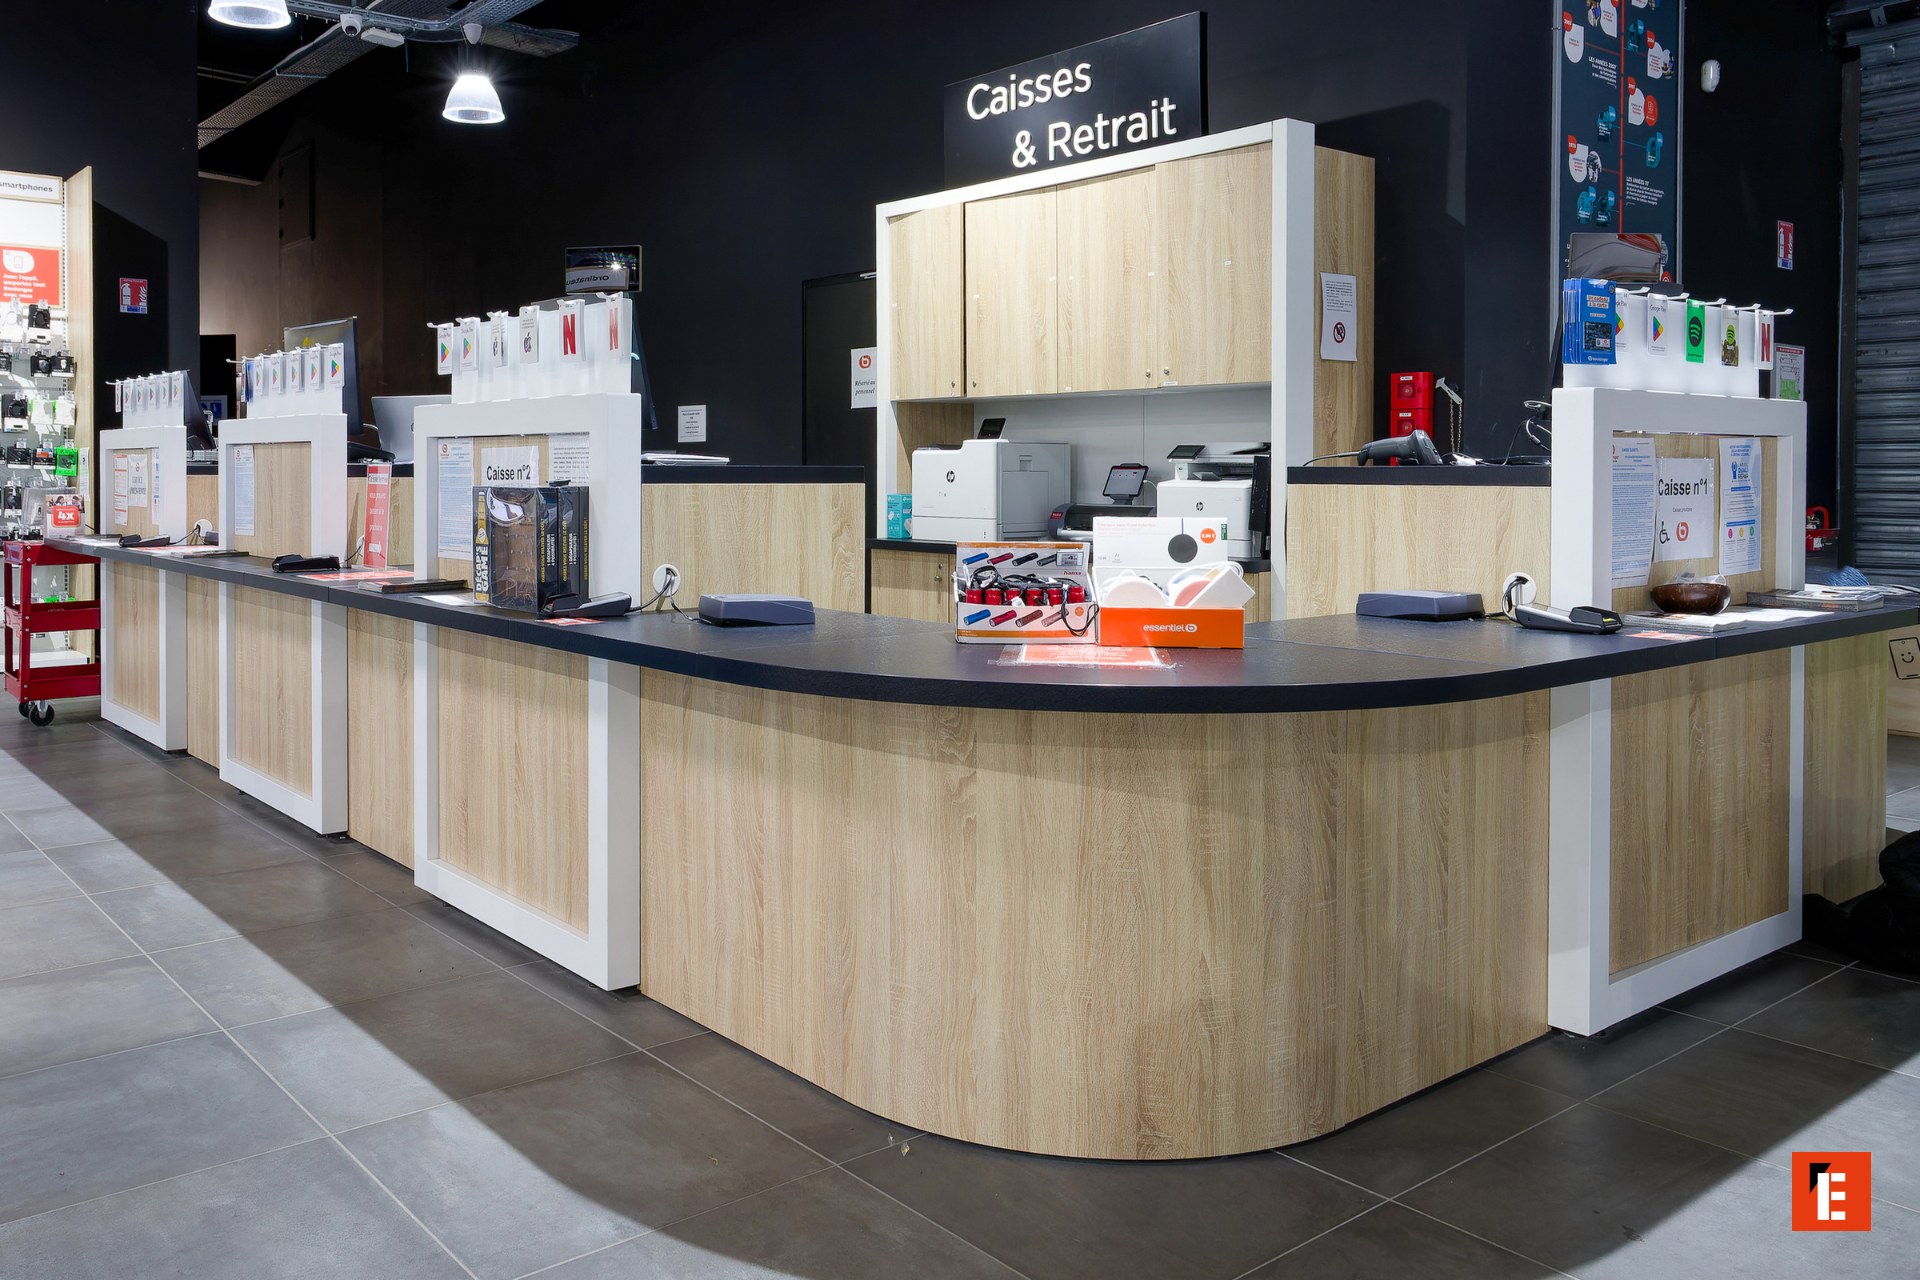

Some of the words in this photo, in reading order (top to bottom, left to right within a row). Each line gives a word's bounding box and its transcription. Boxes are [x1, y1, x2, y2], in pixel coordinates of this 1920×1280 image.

[966, 62, 1092, 120] Caisses
[1012, 130, 1037, 168] &
[1048, 97, 1177, 161] Retrait
[487, 466, 514, 480] Caisse
[517, 464, 531, 480] n°2
[1658, 479, 1690, 496] Caisse
[1694, 478, 1708, 495] n°1
